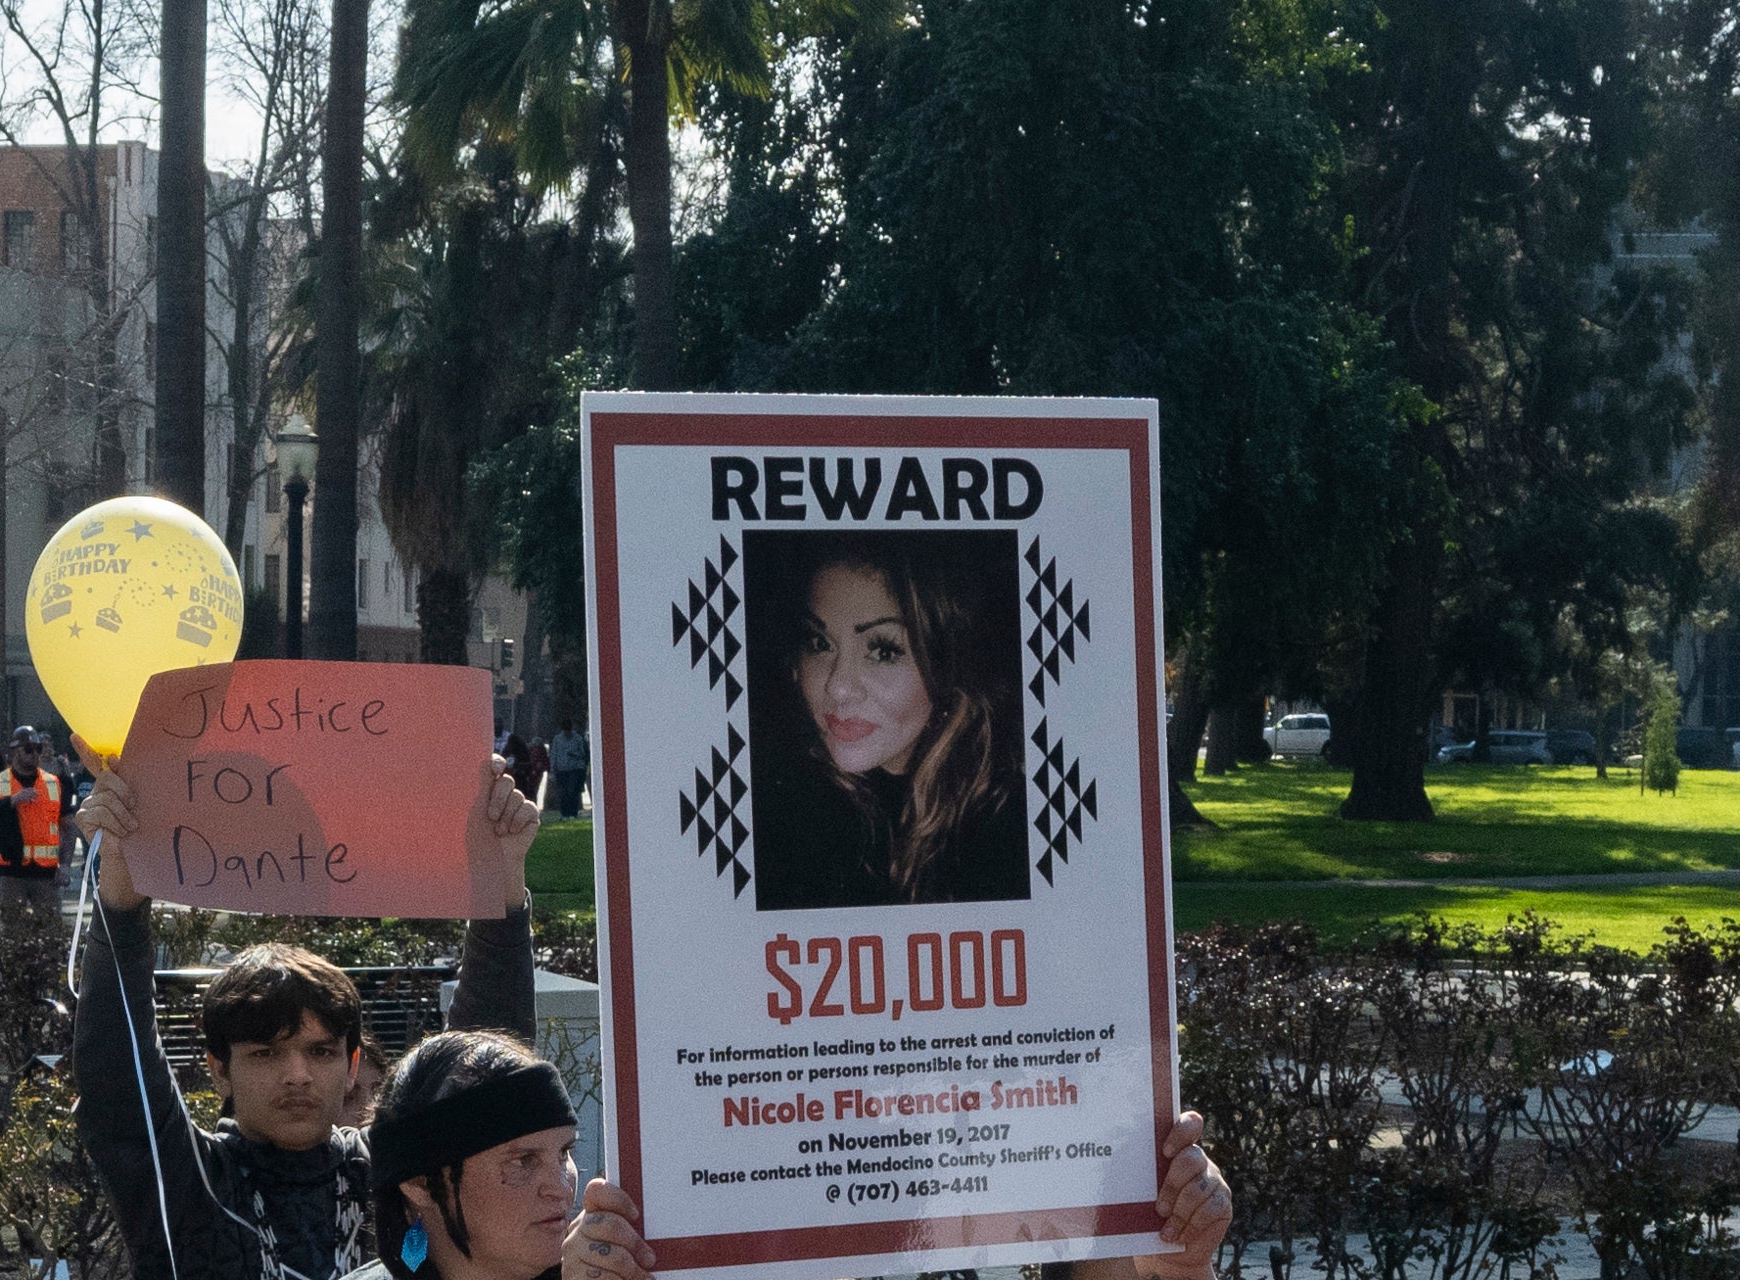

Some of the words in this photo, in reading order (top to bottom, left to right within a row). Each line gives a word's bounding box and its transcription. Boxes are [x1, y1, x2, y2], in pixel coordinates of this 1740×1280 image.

[711, 456, 1045, 522] REWARD
[59, 543, 121, 563] HAPPY
[162, 686, 389, 739] Justice
[174, 825, 358, 889] Dante
[764, 928, 1028, 1025] $20,000
[677, 1047, 705, 1065] For
[709, 1042, 809, 1064] information
[813, 1038, 875, 1061] leading
[879, 1038, 896, 1054] to
[900, 1035, 927, 1052] the
[930, 1032, 978, 1050] arrest
[981, 1029, 1013, 1046] and
[1016, 1025, 1095, 1045] conviction
[1099, 1024, 1116, 1041] of
[695, 1070, 723, 1087] the
[727, 1068, 783, 1088] person
[786, 1066, 804, 1081] or
[809, 1062, 869, 1084] persons
[872, 1055, 962, 1081] responsible
[965, 1053, 990, 1070] for
[993, 1052, 1020, 1069] the
[1023, 1048, 1081, 1067] murder
[1085, 1047, 1102, 1064] of
[723, 1090, 824, 1128] Nicole
[834, 1085, 981, 1122] Florencia
[990, 1077, 1079, 1111] Smith
[798, 1136, 823, 1155] on
[828, 1129, 932, 1153] November
[936, 1127, 964, 1147] 19,
[968, 1124, 1011, 1143] 2017
[691, 1168, 746, 1186] Please
[749, 1163, 812, 1183] contact
[815, 1160, 842, 1178] the
[846, 1153, 934, 1176] Mendocino
[938, 1149, 996, 1170] County
[1000, 1143, 1061, 1163] Sheriff's
[1065, 1142, 1112, 1160] Office
[825, 1185, 841, 1202] @
[846, 1180, 900, 1206] (707)
[905, 1176, 989, 1198] 463-4411
